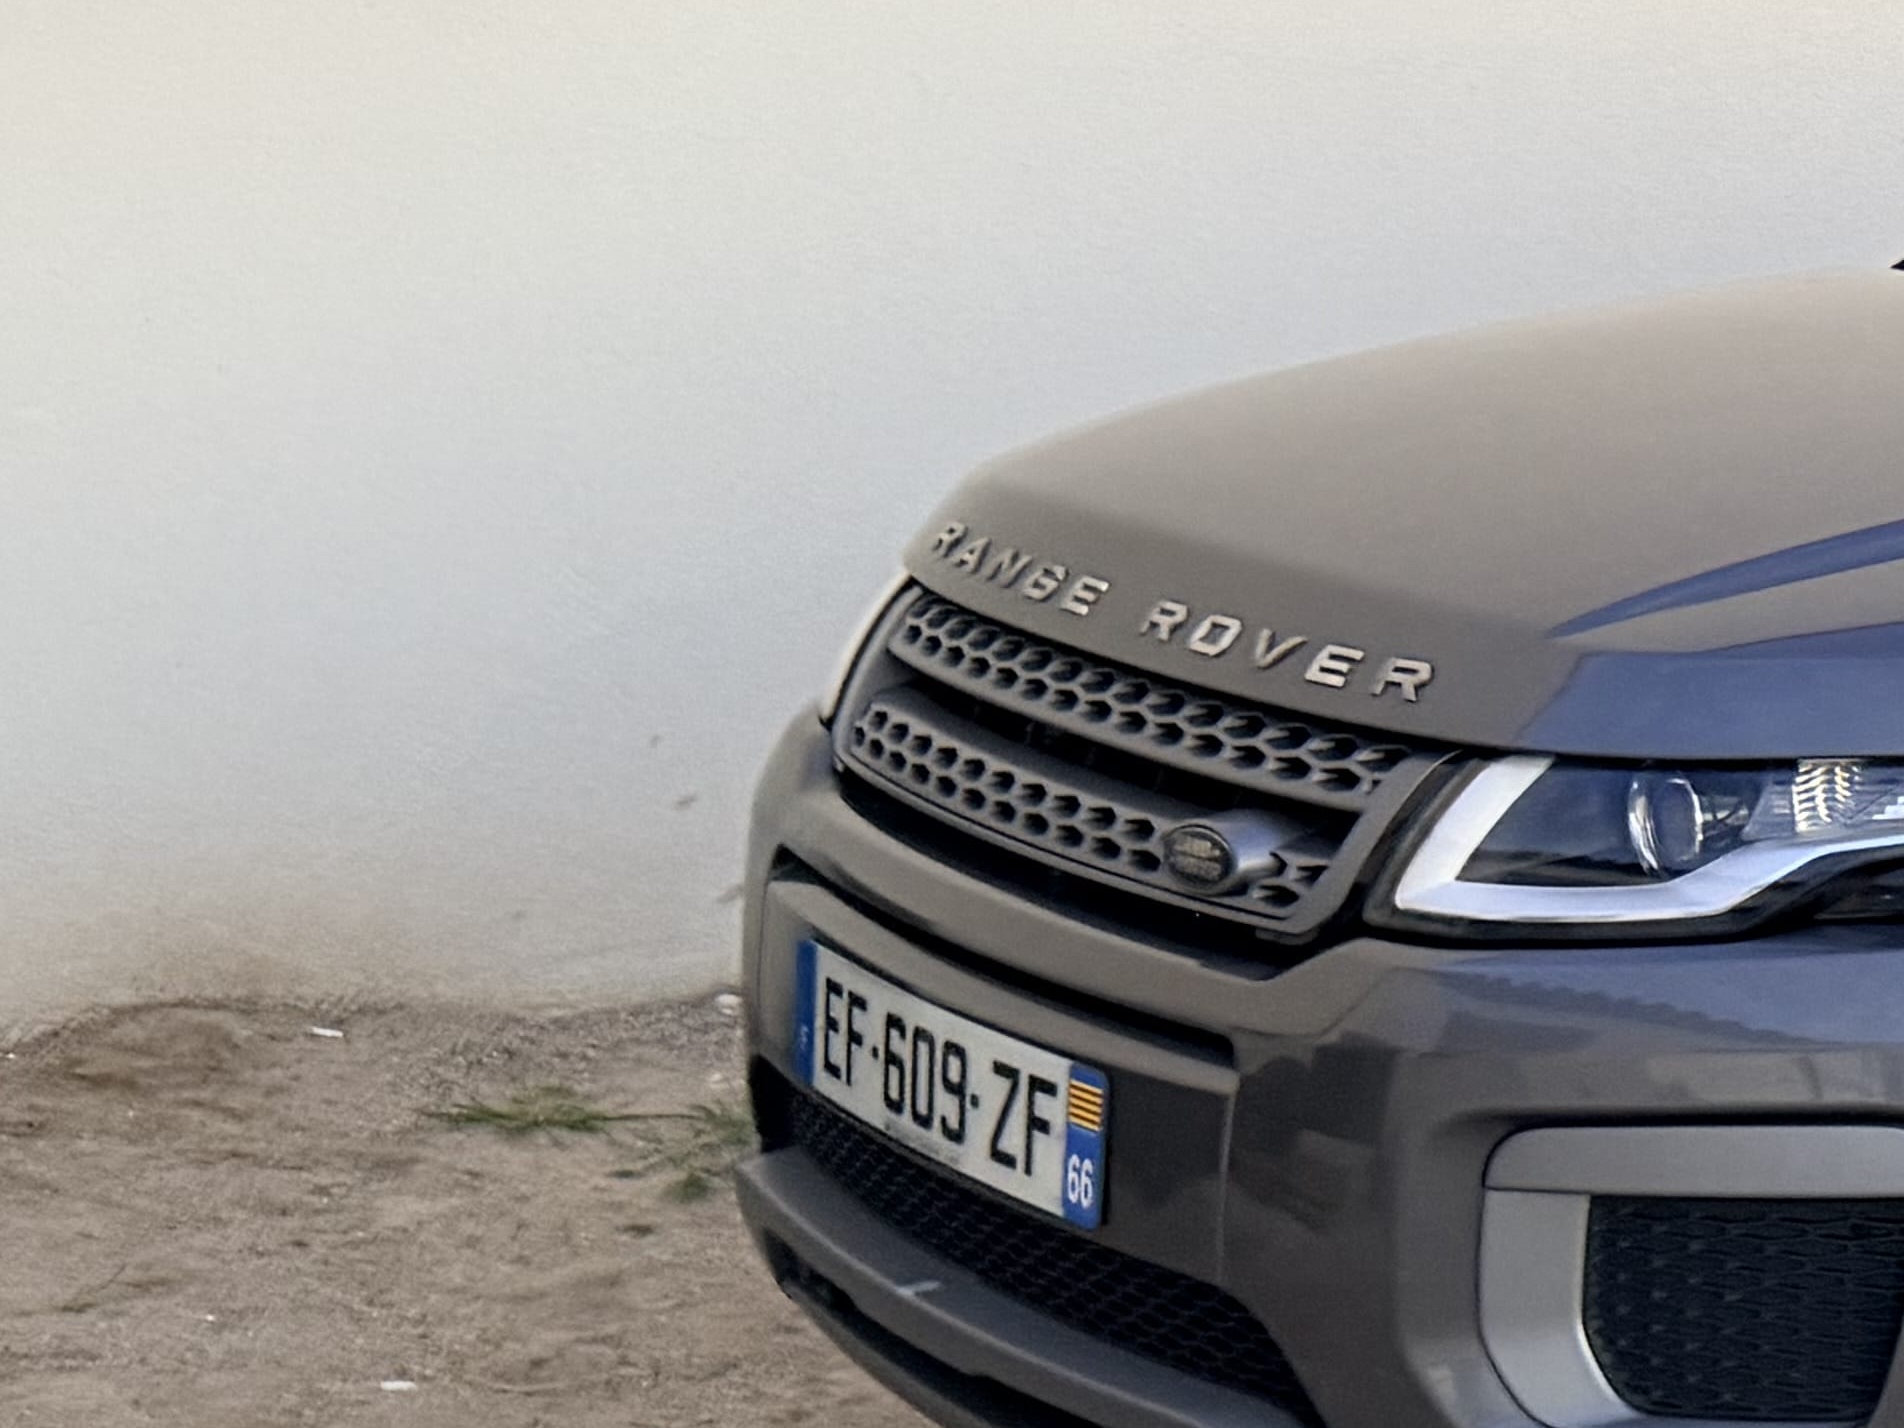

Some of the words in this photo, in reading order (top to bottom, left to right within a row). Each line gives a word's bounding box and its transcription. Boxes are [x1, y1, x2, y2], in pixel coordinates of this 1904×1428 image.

[930, 520, 1110, 617] RANGE
[1138, 599, 1435, 703] ROVER
[1067, 1153, 1095, 1210] 66
